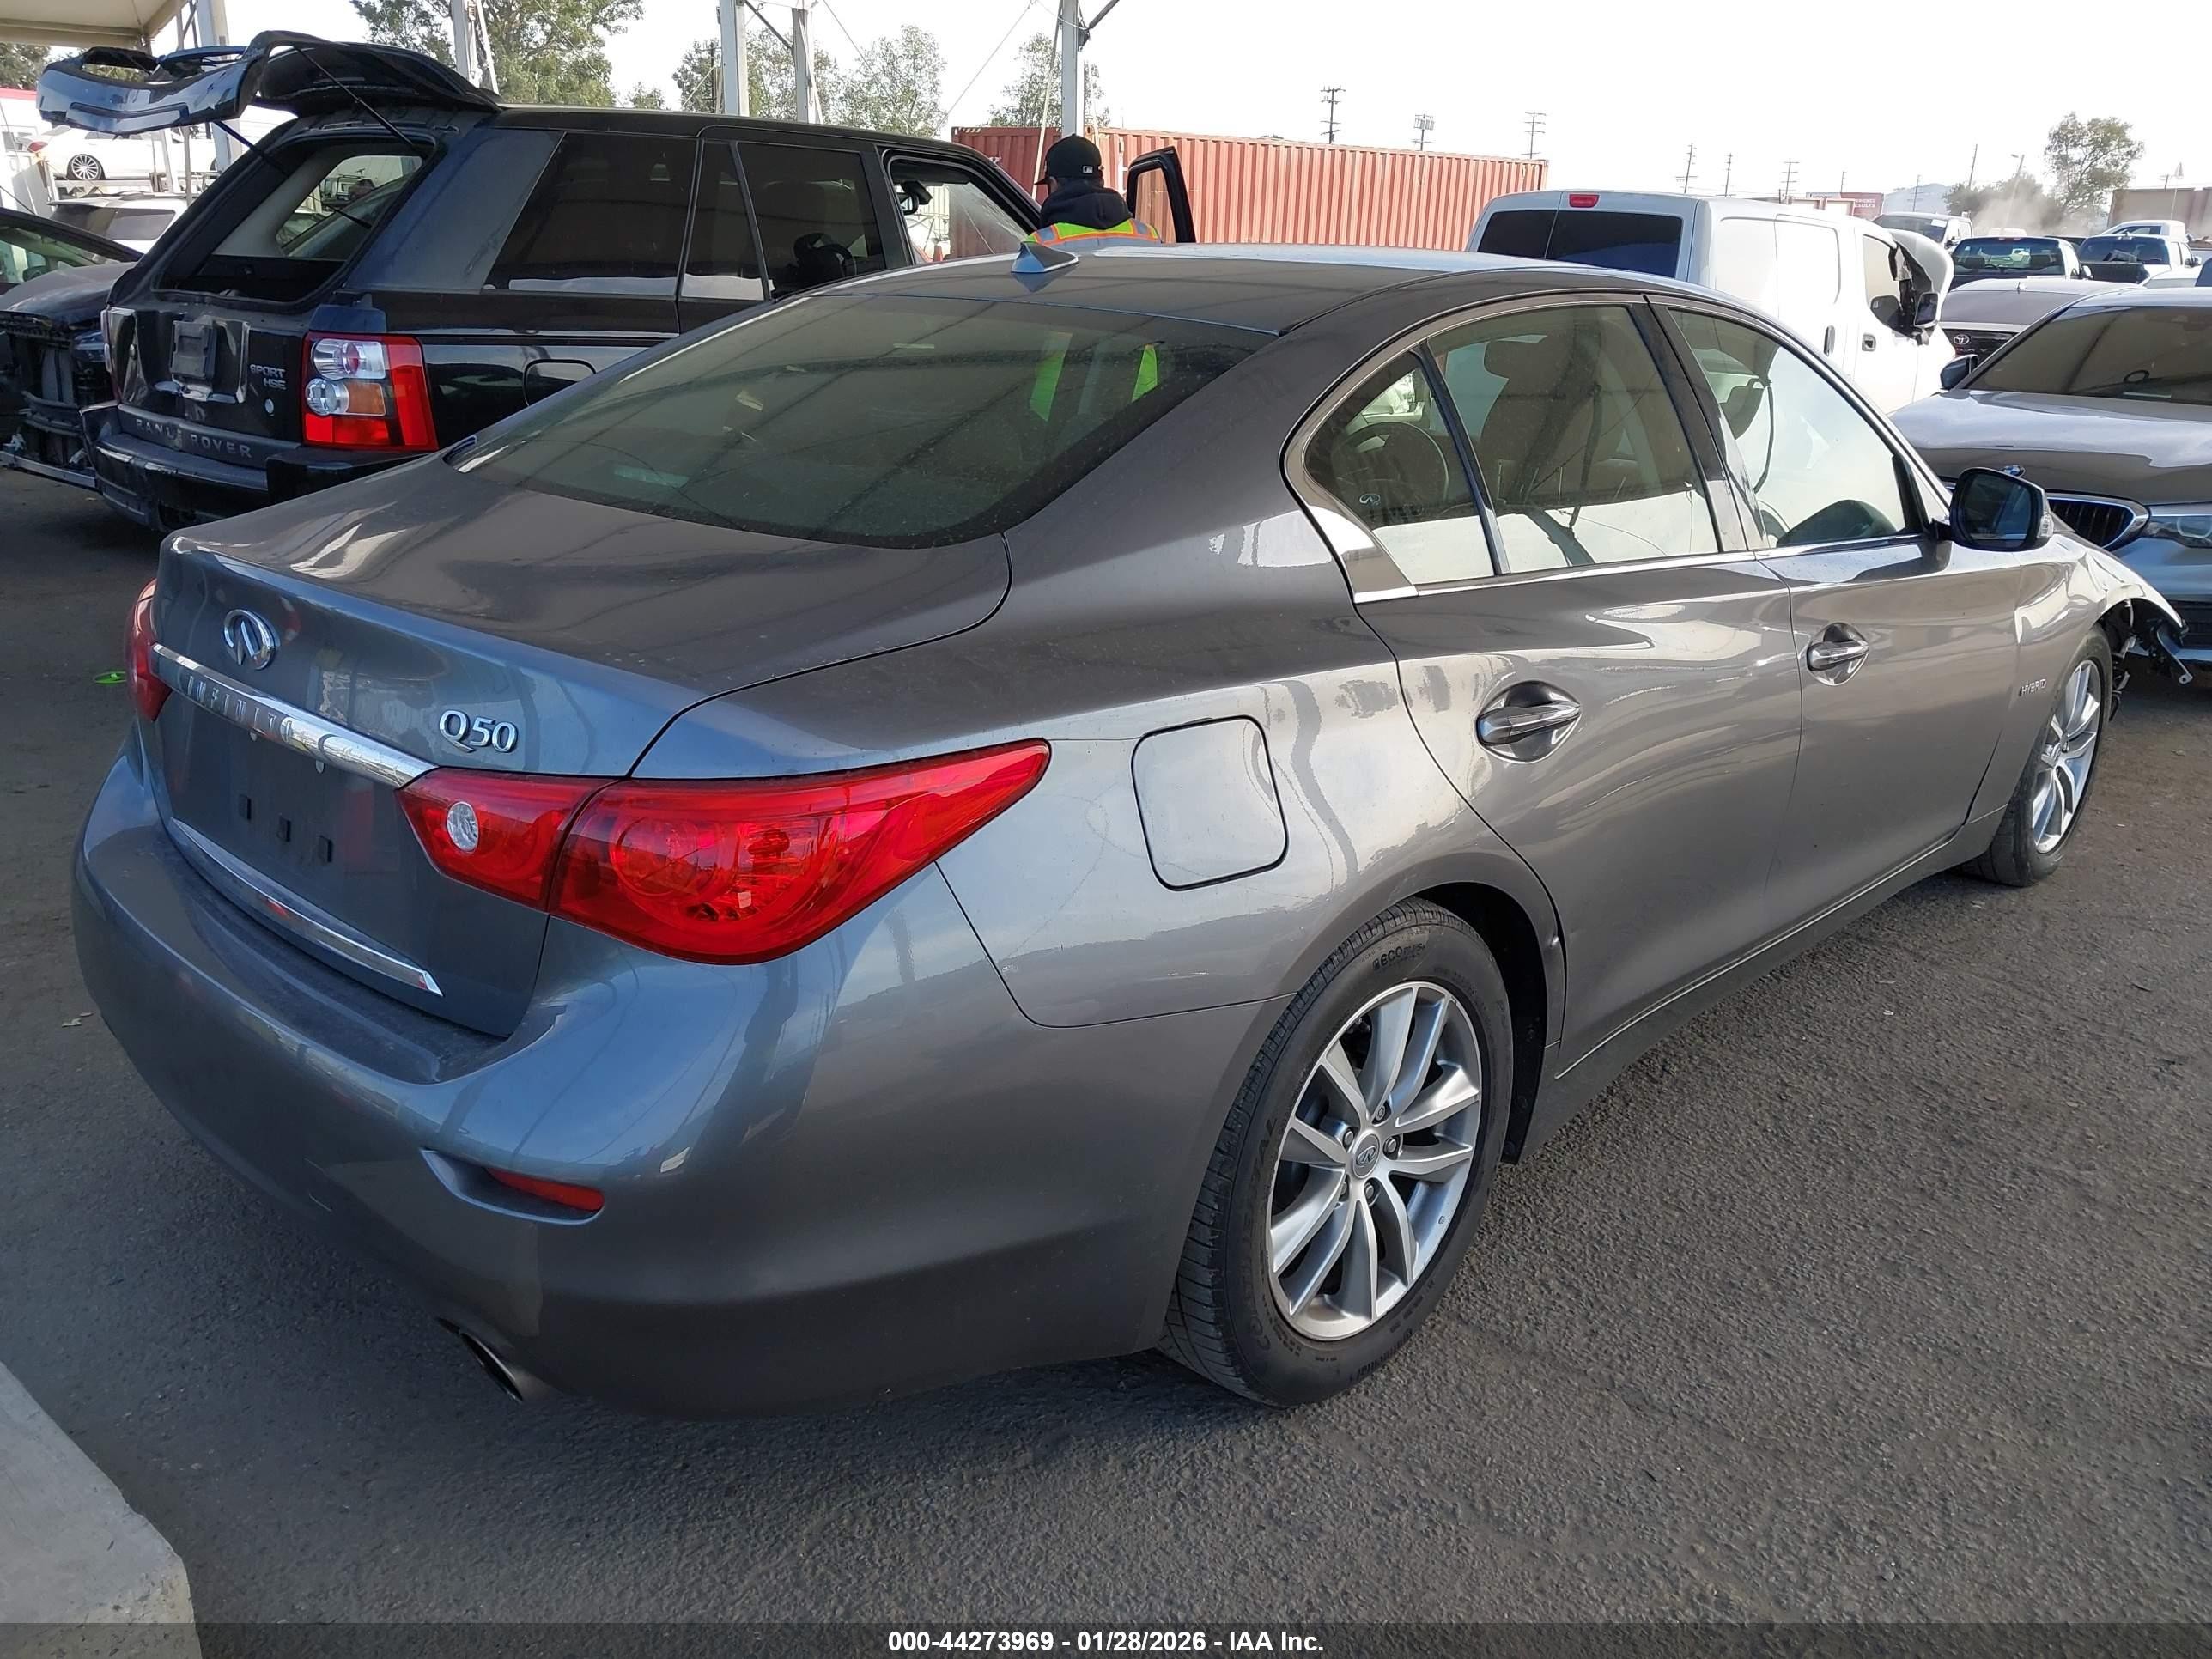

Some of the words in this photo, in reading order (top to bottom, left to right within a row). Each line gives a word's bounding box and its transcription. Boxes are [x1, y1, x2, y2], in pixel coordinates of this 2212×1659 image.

[250, 364, 285, 378] SPORT
[263, 378, 286, 390] HSE
[190, 434, 252, 458] ROVER
[186, 675, 293, 743] INFINITI
[439, 710, 518, 753] Q50
